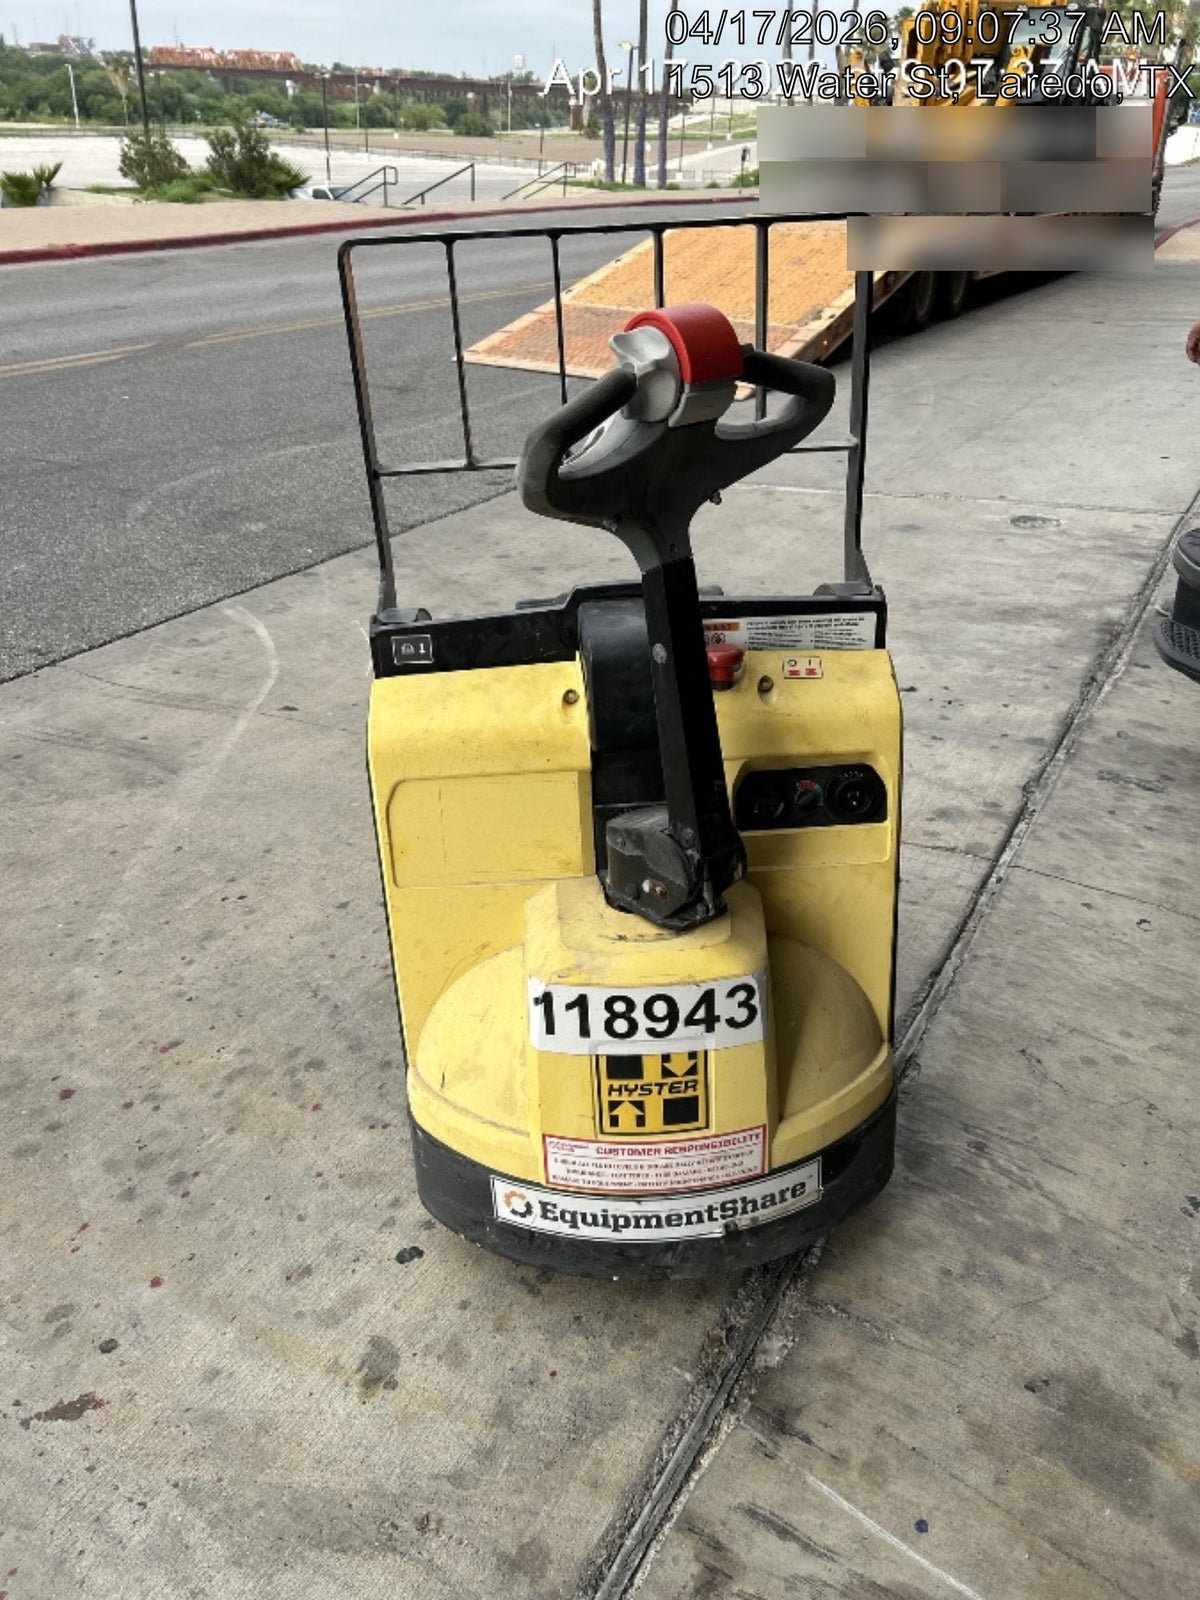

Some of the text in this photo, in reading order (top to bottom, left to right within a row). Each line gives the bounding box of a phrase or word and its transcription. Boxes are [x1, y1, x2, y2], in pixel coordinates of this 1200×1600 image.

[533, 982, 758, 1040] 118943
[607, 1079, 699, 1097] HYSTER
[596, 1146, 661, 1157] CUSTOMER
[536, 1180, 808, 1233] EquipmentShare
